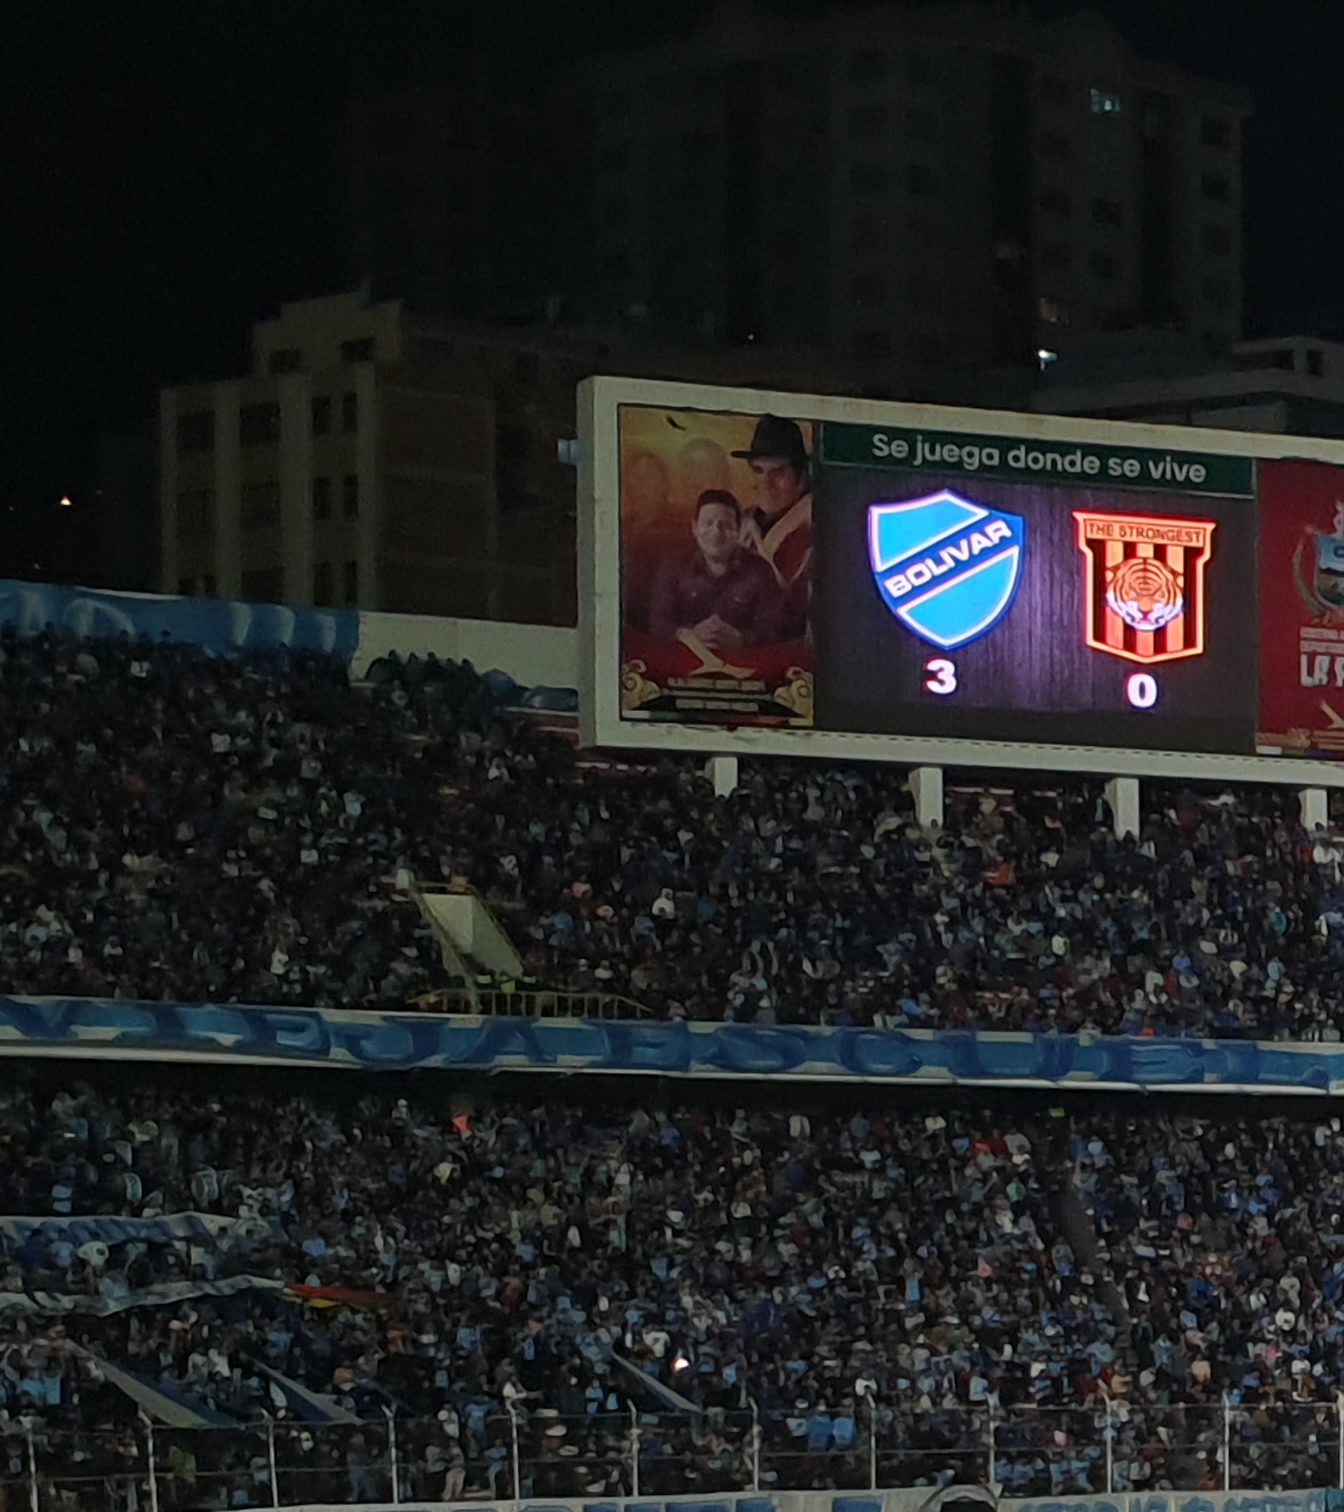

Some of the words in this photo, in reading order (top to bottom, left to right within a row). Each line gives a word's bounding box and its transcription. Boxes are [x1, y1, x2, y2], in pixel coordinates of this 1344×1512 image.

[872, 433, 909, 458] Se
[913, 435, 1000, 471] juega
[1008, 445, 1100, 475] donde
[1107, 457, 1141, 477] se
[1148, 456, 1206, 483] vive
[1088, 521, 1114, 538] THE
[1119, 526, 1202, 544] STRONGEST
[884, 519, 1013, 598] BOLIVAR
[926, 659, 957, 695] 3
[1127, 674, 1157, 708] 0
